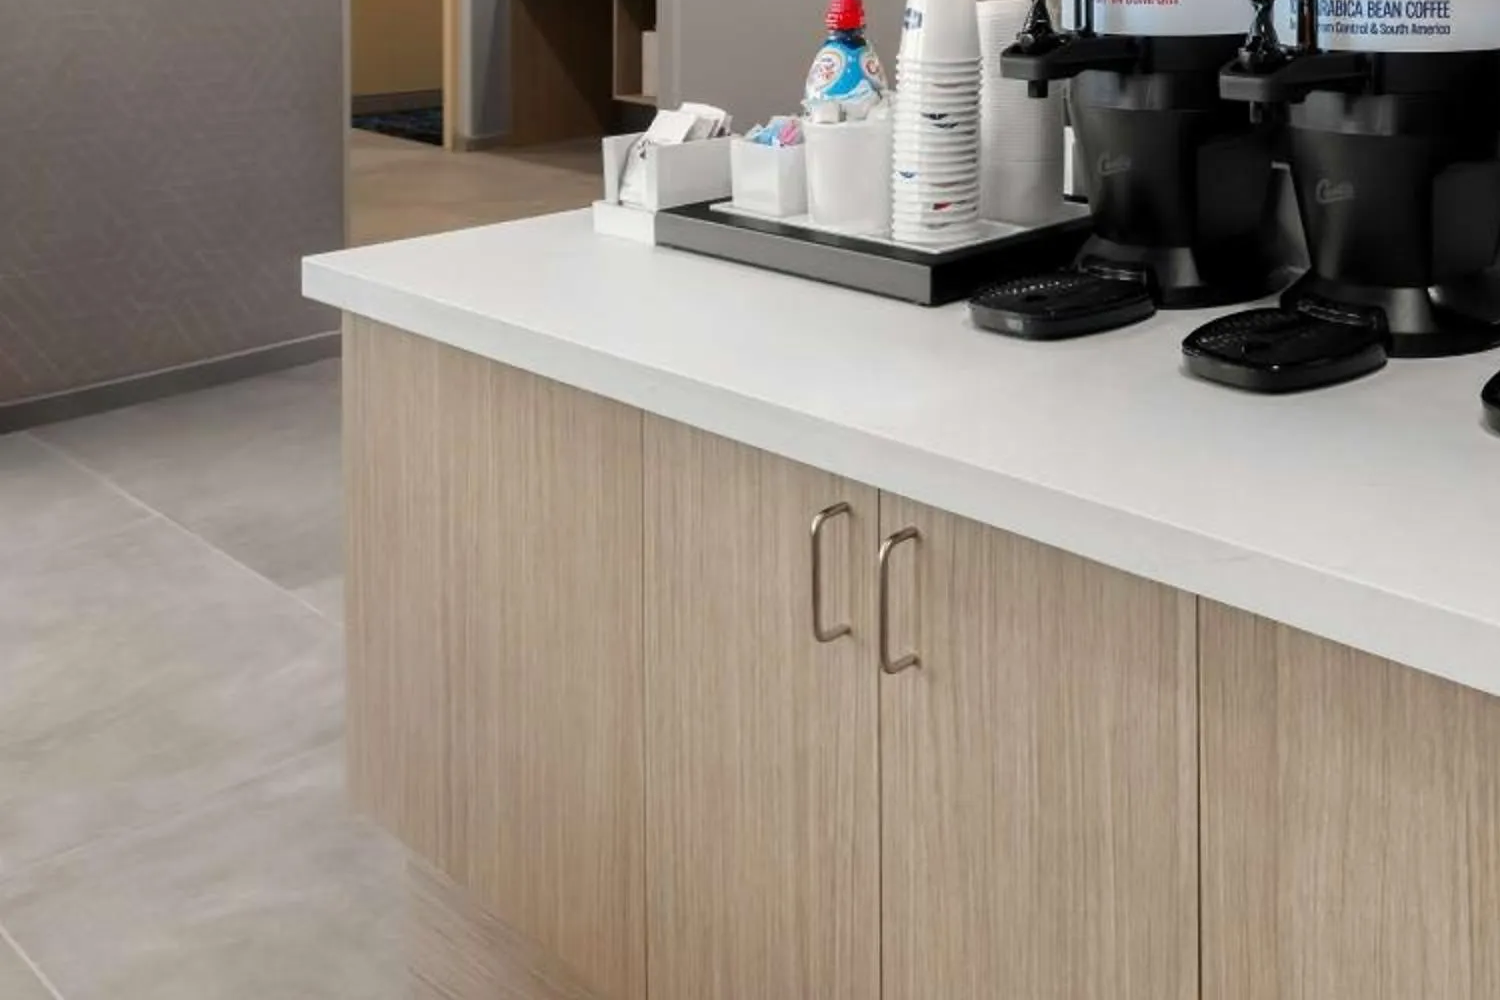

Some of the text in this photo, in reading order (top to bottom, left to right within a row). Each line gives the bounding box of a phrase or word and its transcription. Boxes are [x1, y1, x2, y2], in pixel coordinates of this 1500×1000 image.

[1319, 0, 1363, 18] RABICA
[1367, 0, 1403, 18] BEAN
[1405, 0, 1451, 19] COFFEE
[1380, 23, 1409, 35] South
